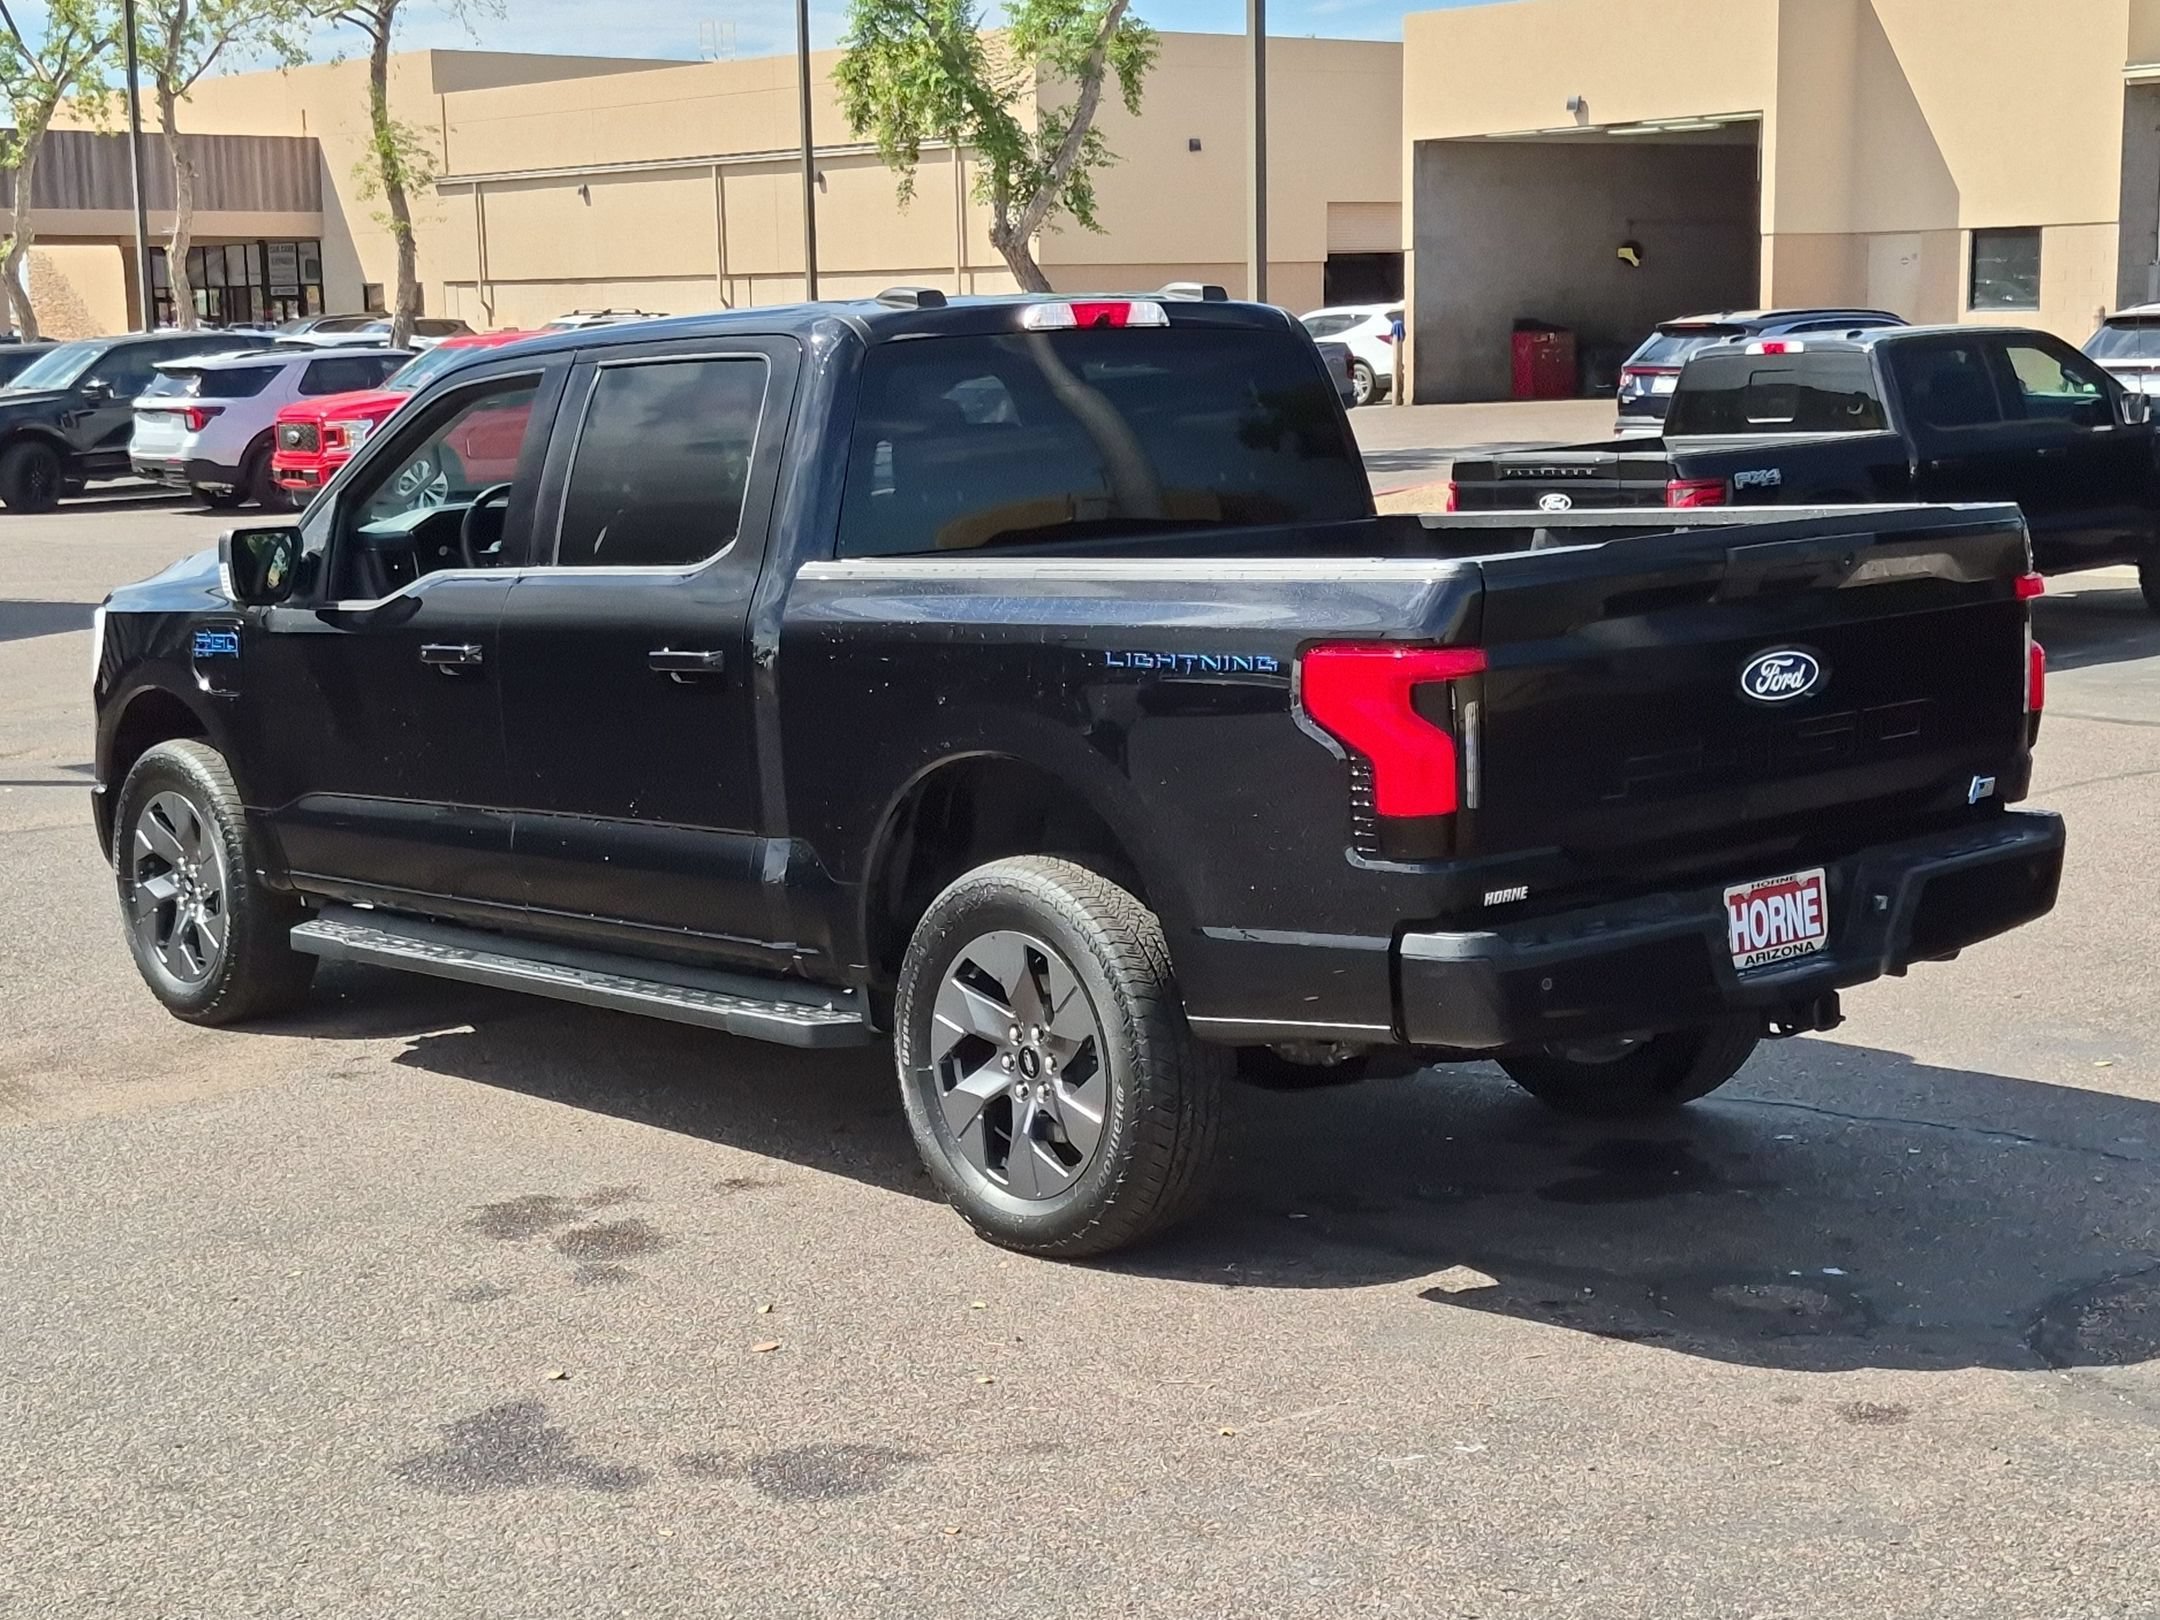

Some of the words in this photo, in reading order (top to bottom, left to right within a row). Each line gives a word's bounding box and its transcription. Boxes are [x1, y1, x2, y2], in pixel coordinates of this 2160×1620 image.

[1734, 468, 1781, 489] FX4
[1105, 651, 1278, 675] LIGHTNING
[1755, 658, 1806, 694] Ford
[1483, 885, 1529, 907] HORNE
[1730, 887, 1821, 954] HORNE
[1744, 941, 1815, 966] ARIZONA
